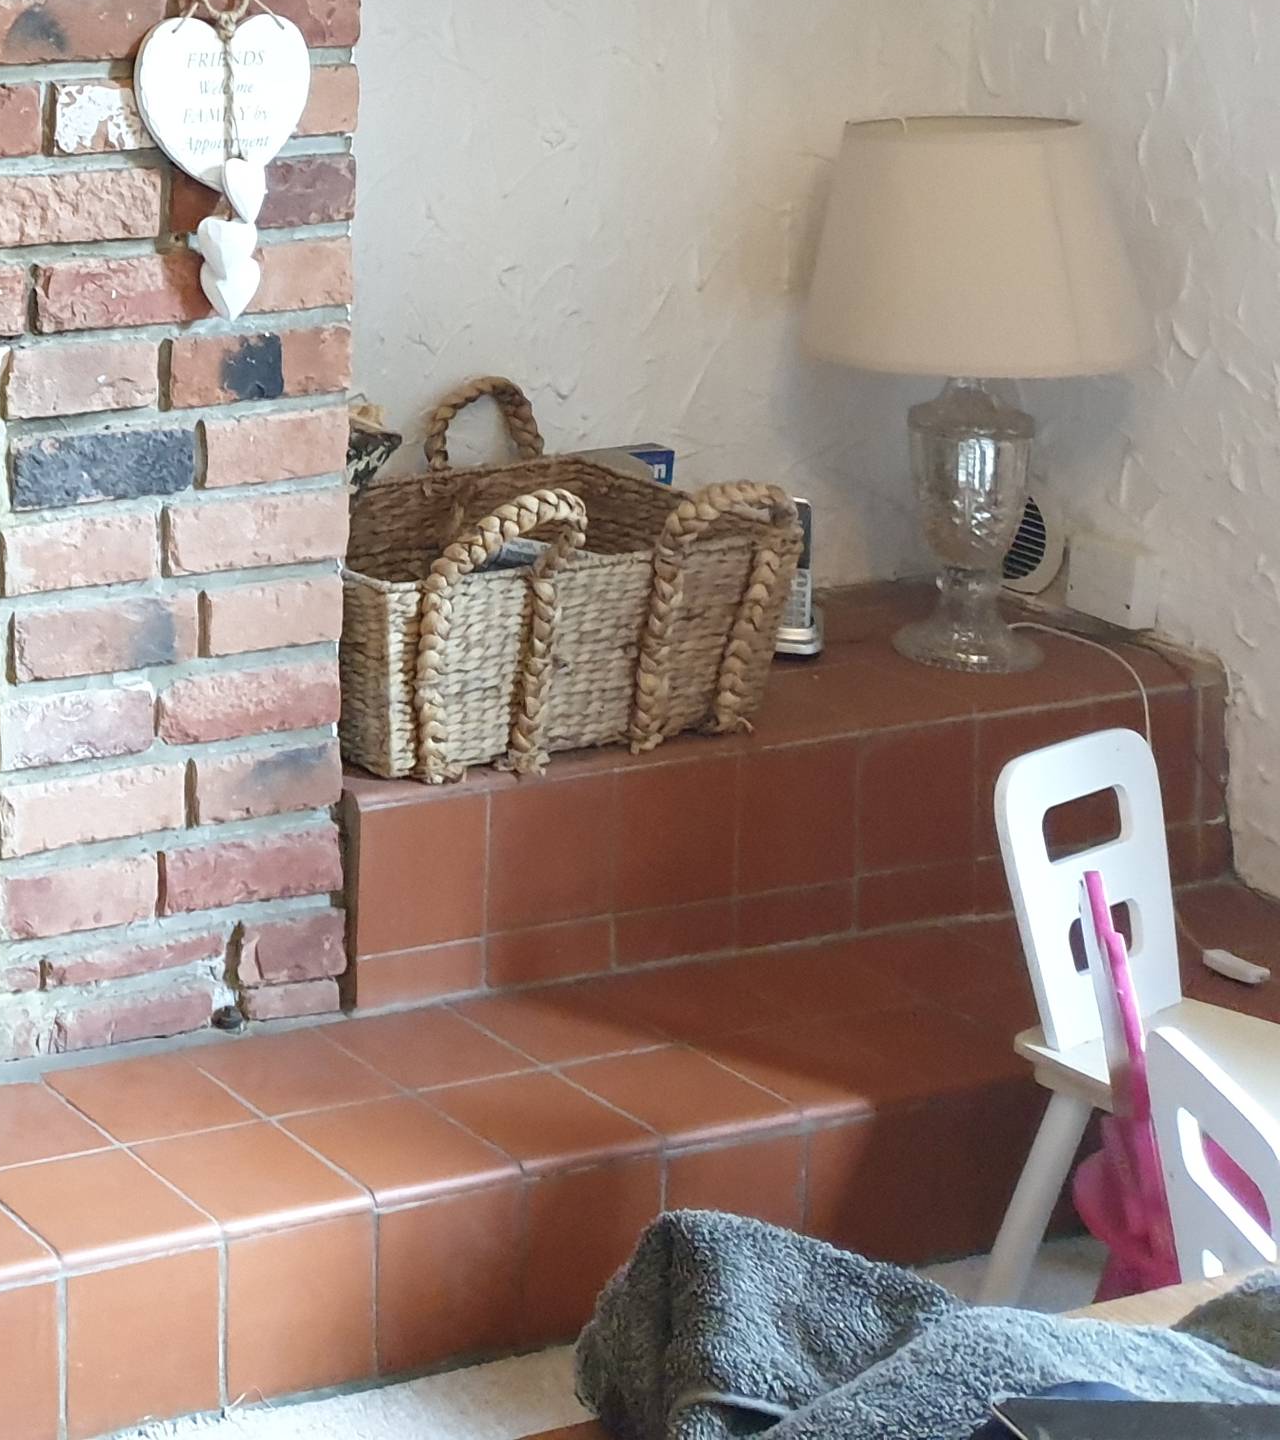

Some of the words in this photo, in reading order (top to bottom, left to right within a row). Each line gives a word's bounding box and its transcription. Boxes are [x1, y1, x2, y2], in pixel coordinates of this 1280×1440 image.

[200, 79, 254, 95] Welme
[184, 105, 251, 124] FAMY
[186, 135, 269, 155] Appoiment
